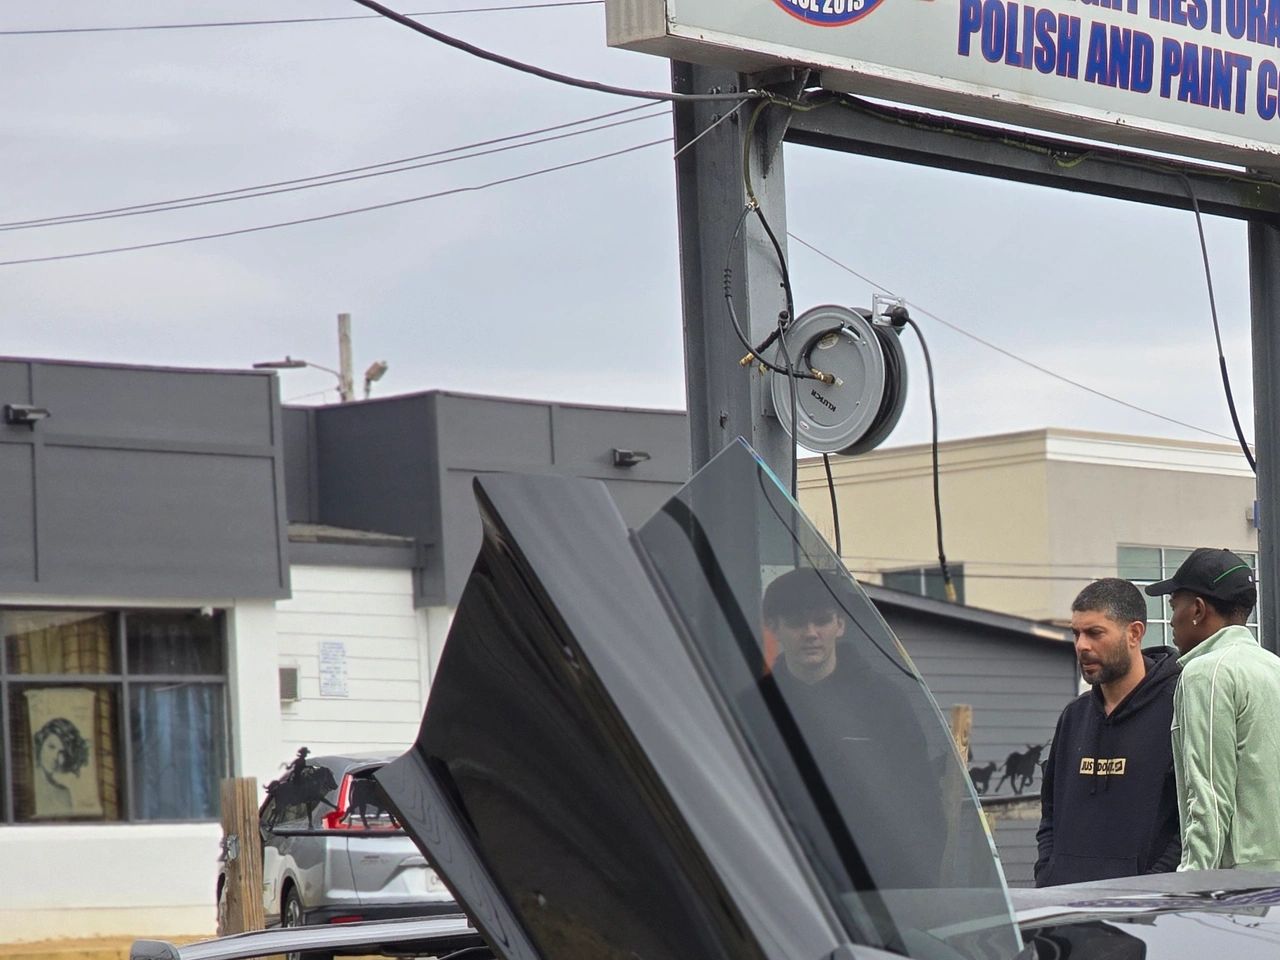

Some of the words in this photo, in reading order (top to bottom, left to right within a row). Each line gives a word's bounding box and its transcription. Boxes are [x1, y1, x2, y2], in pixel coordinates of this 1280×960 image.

[958, 0, 1081, 80] POLISH
[1085, 21, 1155, 94] AND
[1160, 37, 1252, 115] PAINT
